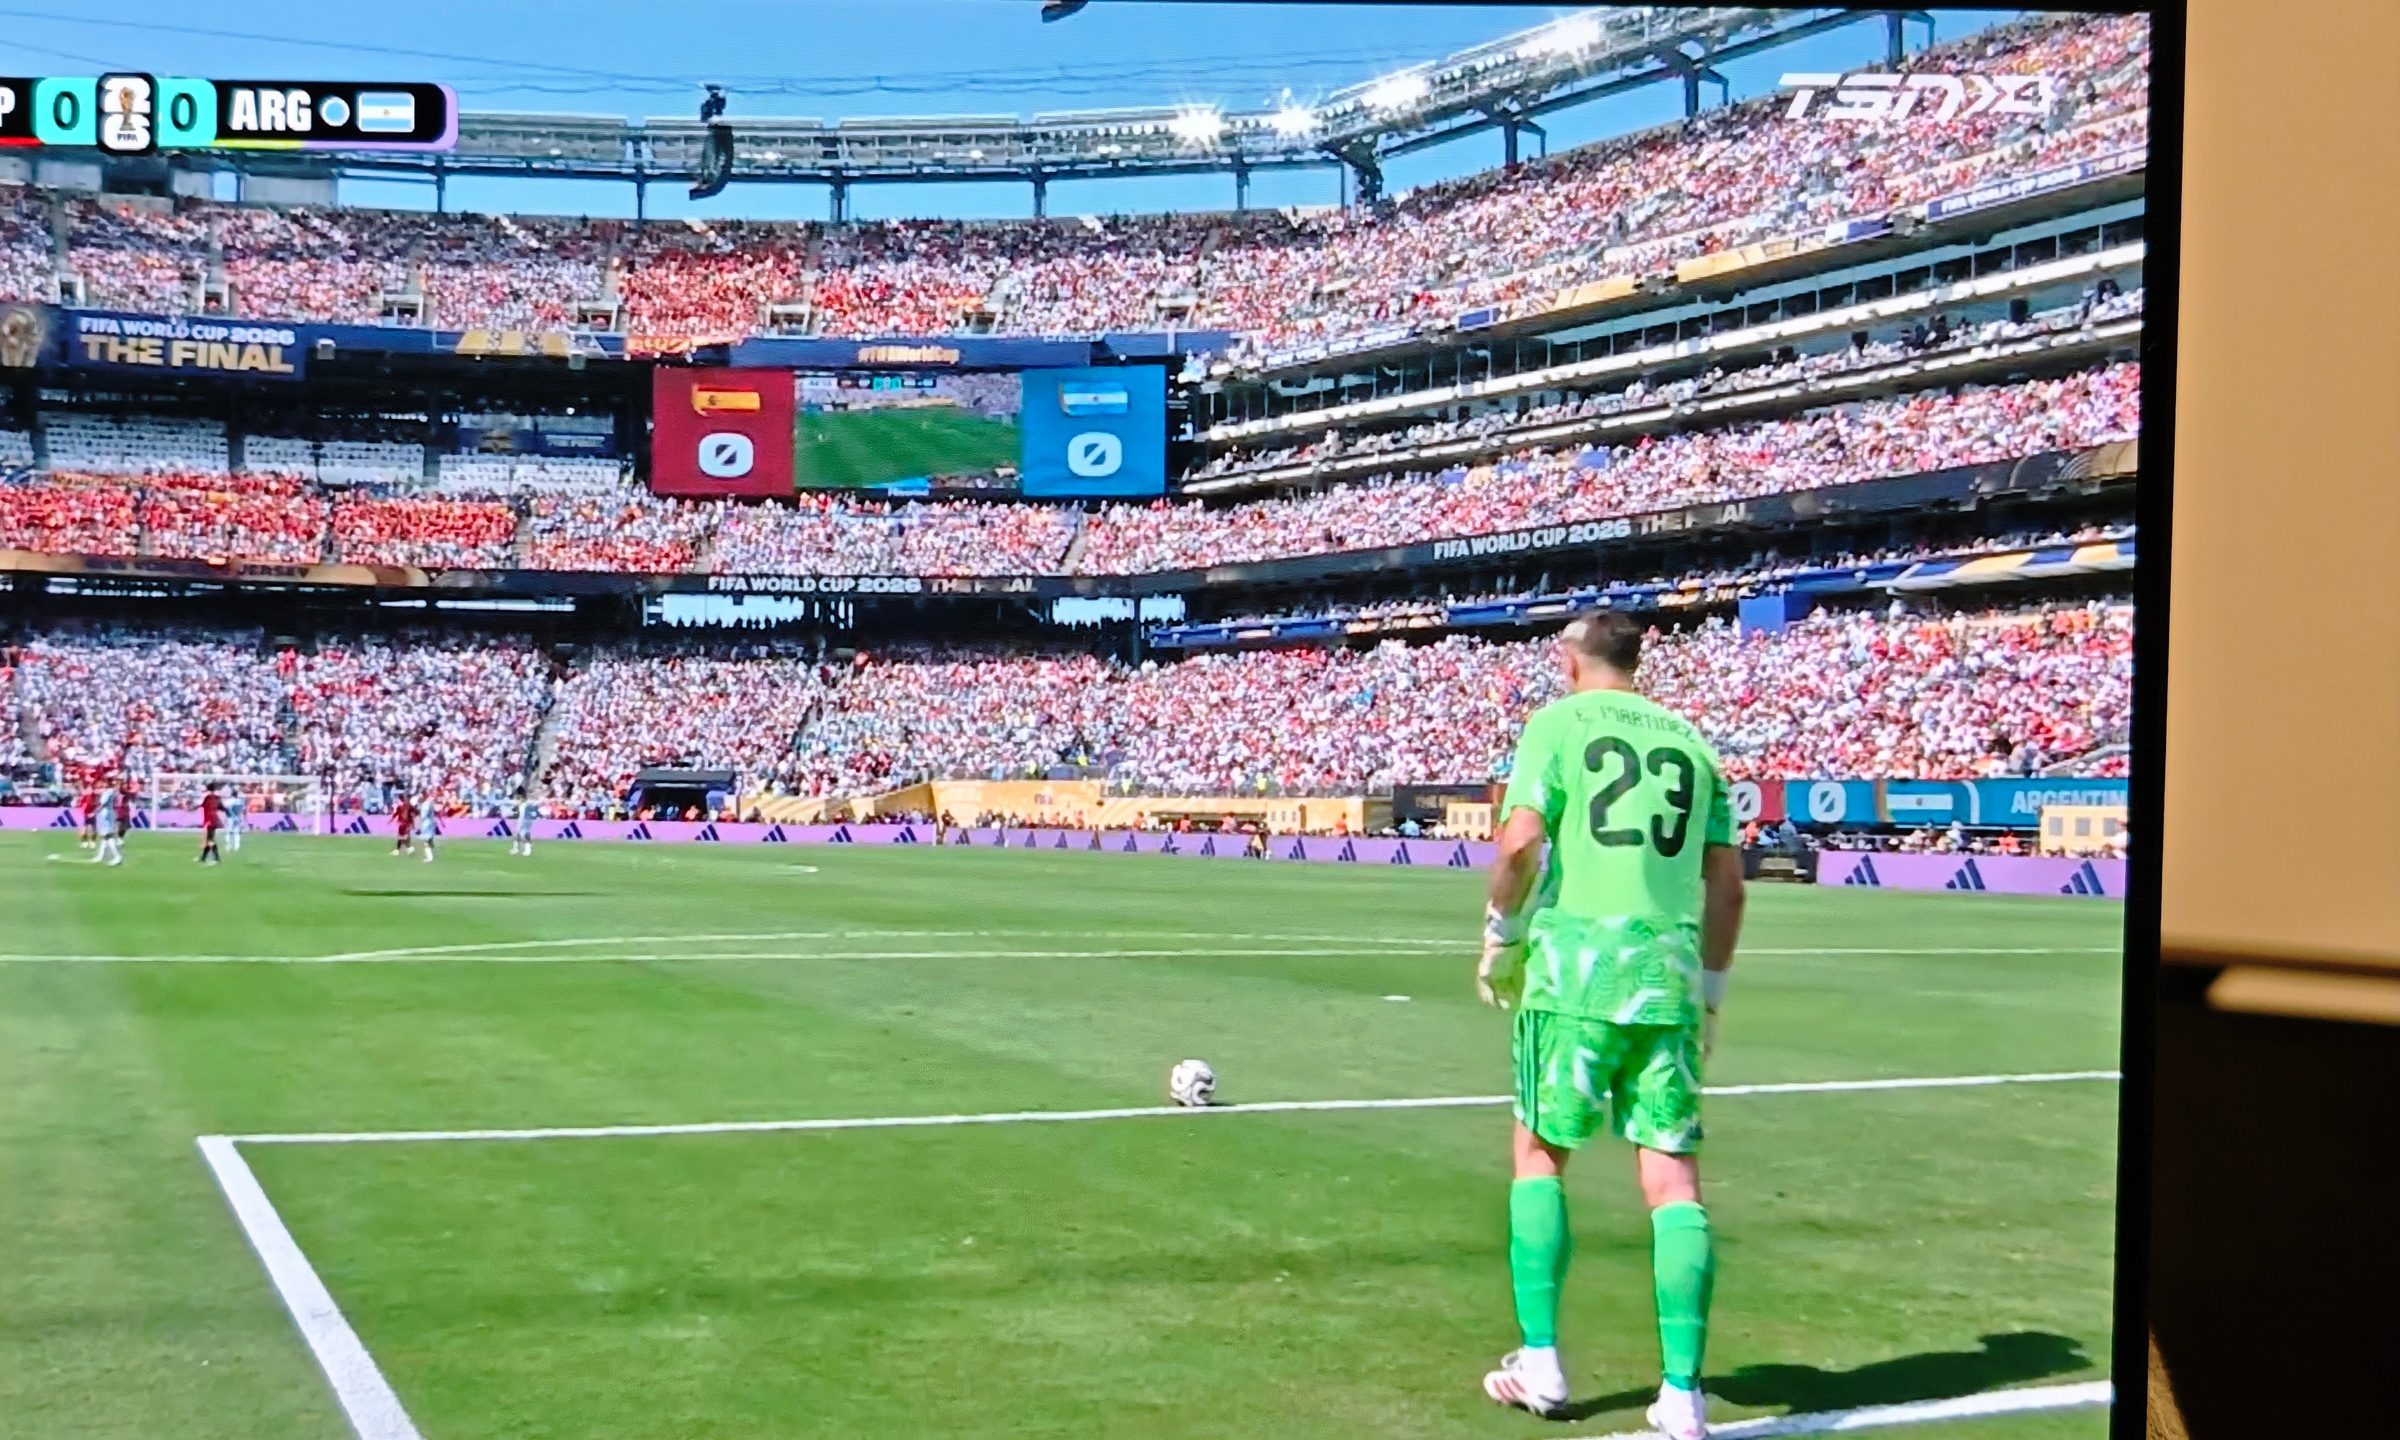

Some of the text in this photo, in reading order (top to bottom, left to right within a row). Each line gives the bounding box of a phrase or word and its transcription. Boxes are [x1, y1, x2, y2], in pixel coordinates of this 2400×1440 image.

[53, 91, 80, 131] 0
[170, 92, 198, 132] 0
[229, 88, 312, 132] ARG
[80, 316, 296, 346] FIFA WORLD CUP 2026
[80, 333, 295, 374] THE FINAL
[1433, 539, 1470, 561] FIFA
[1471, 532, 1530, 556] WORLD
[1532, 527, 1567, 547] CUP
[1568, 519, 1632, 544] 2026
[707, 576, 748, 592] FIFA
[749, 576, 817, 593] WORLD
[818, 576, 856, 593] CUP
[857, 576, 922, 593] 2026
[1584, 735, 1695, 858] 23
